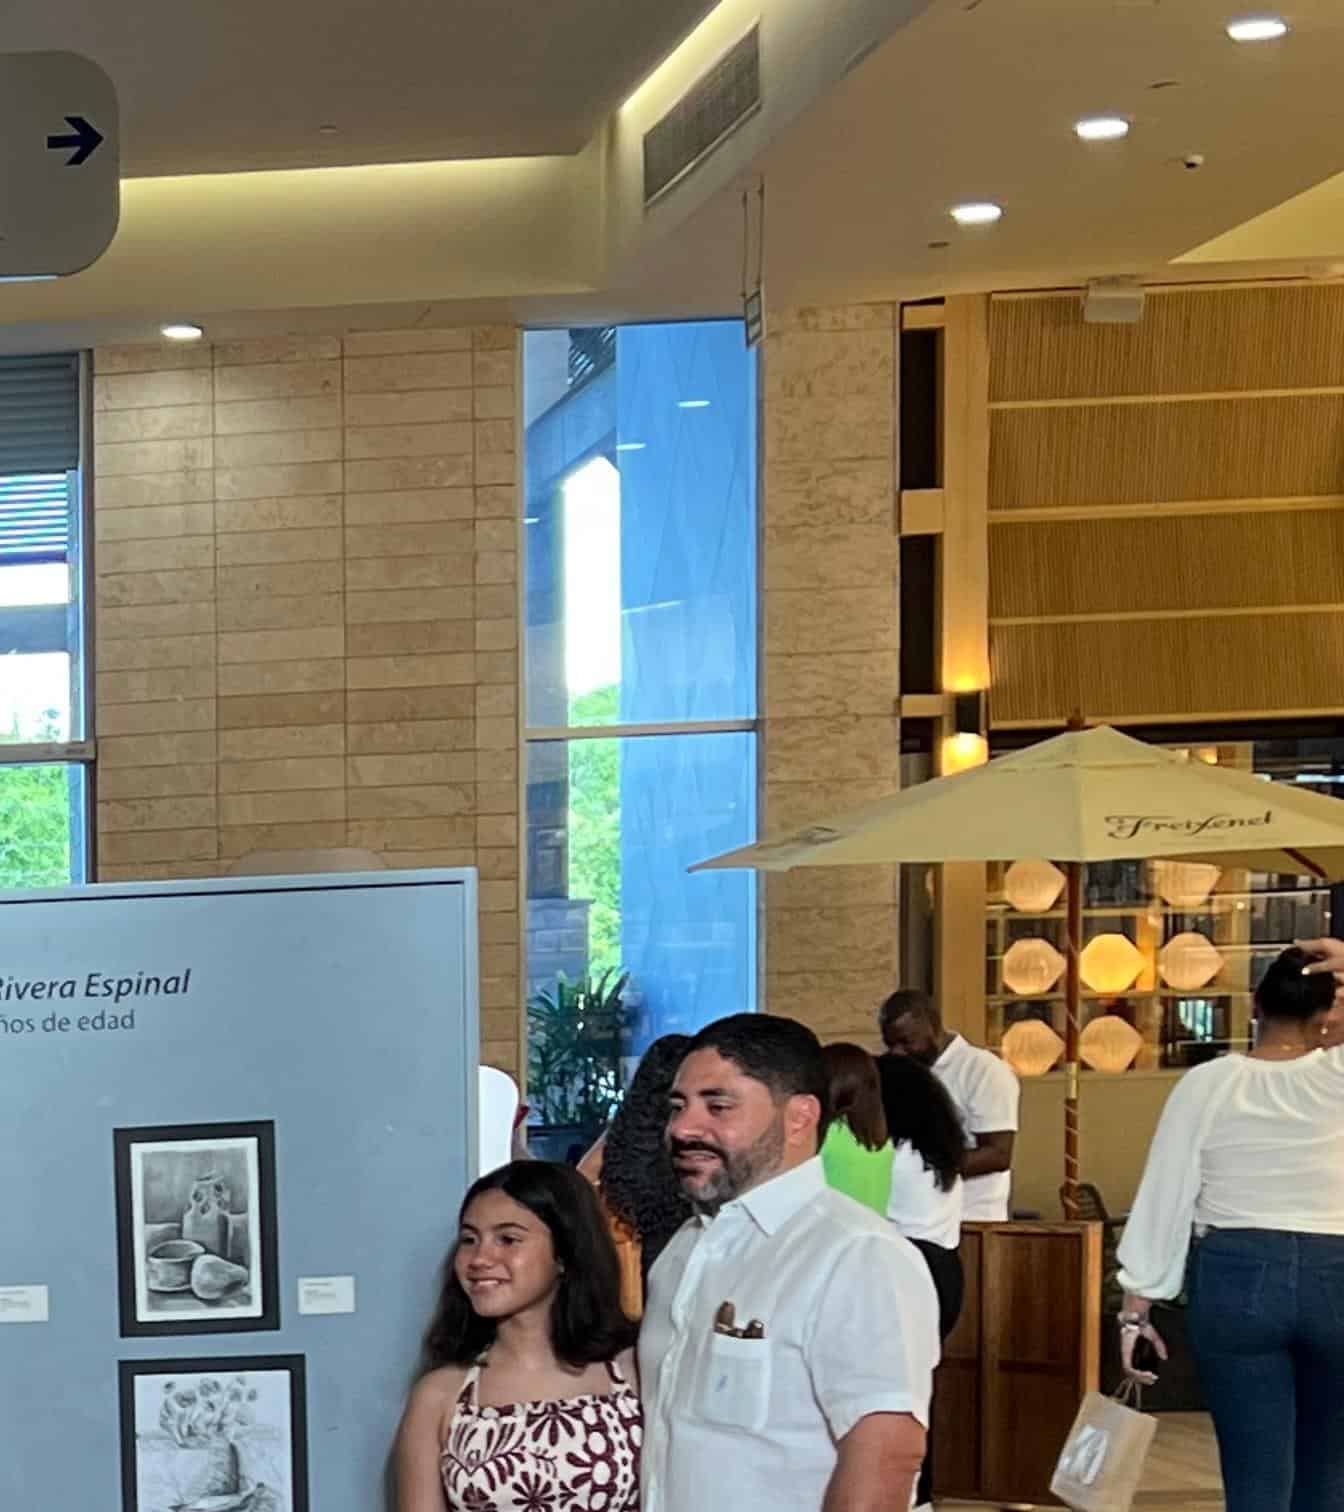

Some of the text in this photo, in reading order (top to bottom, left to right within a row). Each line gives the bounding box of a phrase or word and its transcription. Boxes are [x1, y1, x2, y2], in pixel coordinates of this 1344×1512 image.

[84, 967, 192, 1004] Espinal
[42, 1011, 71, 1033] de
[77, 1009, 137, 1032] edad
